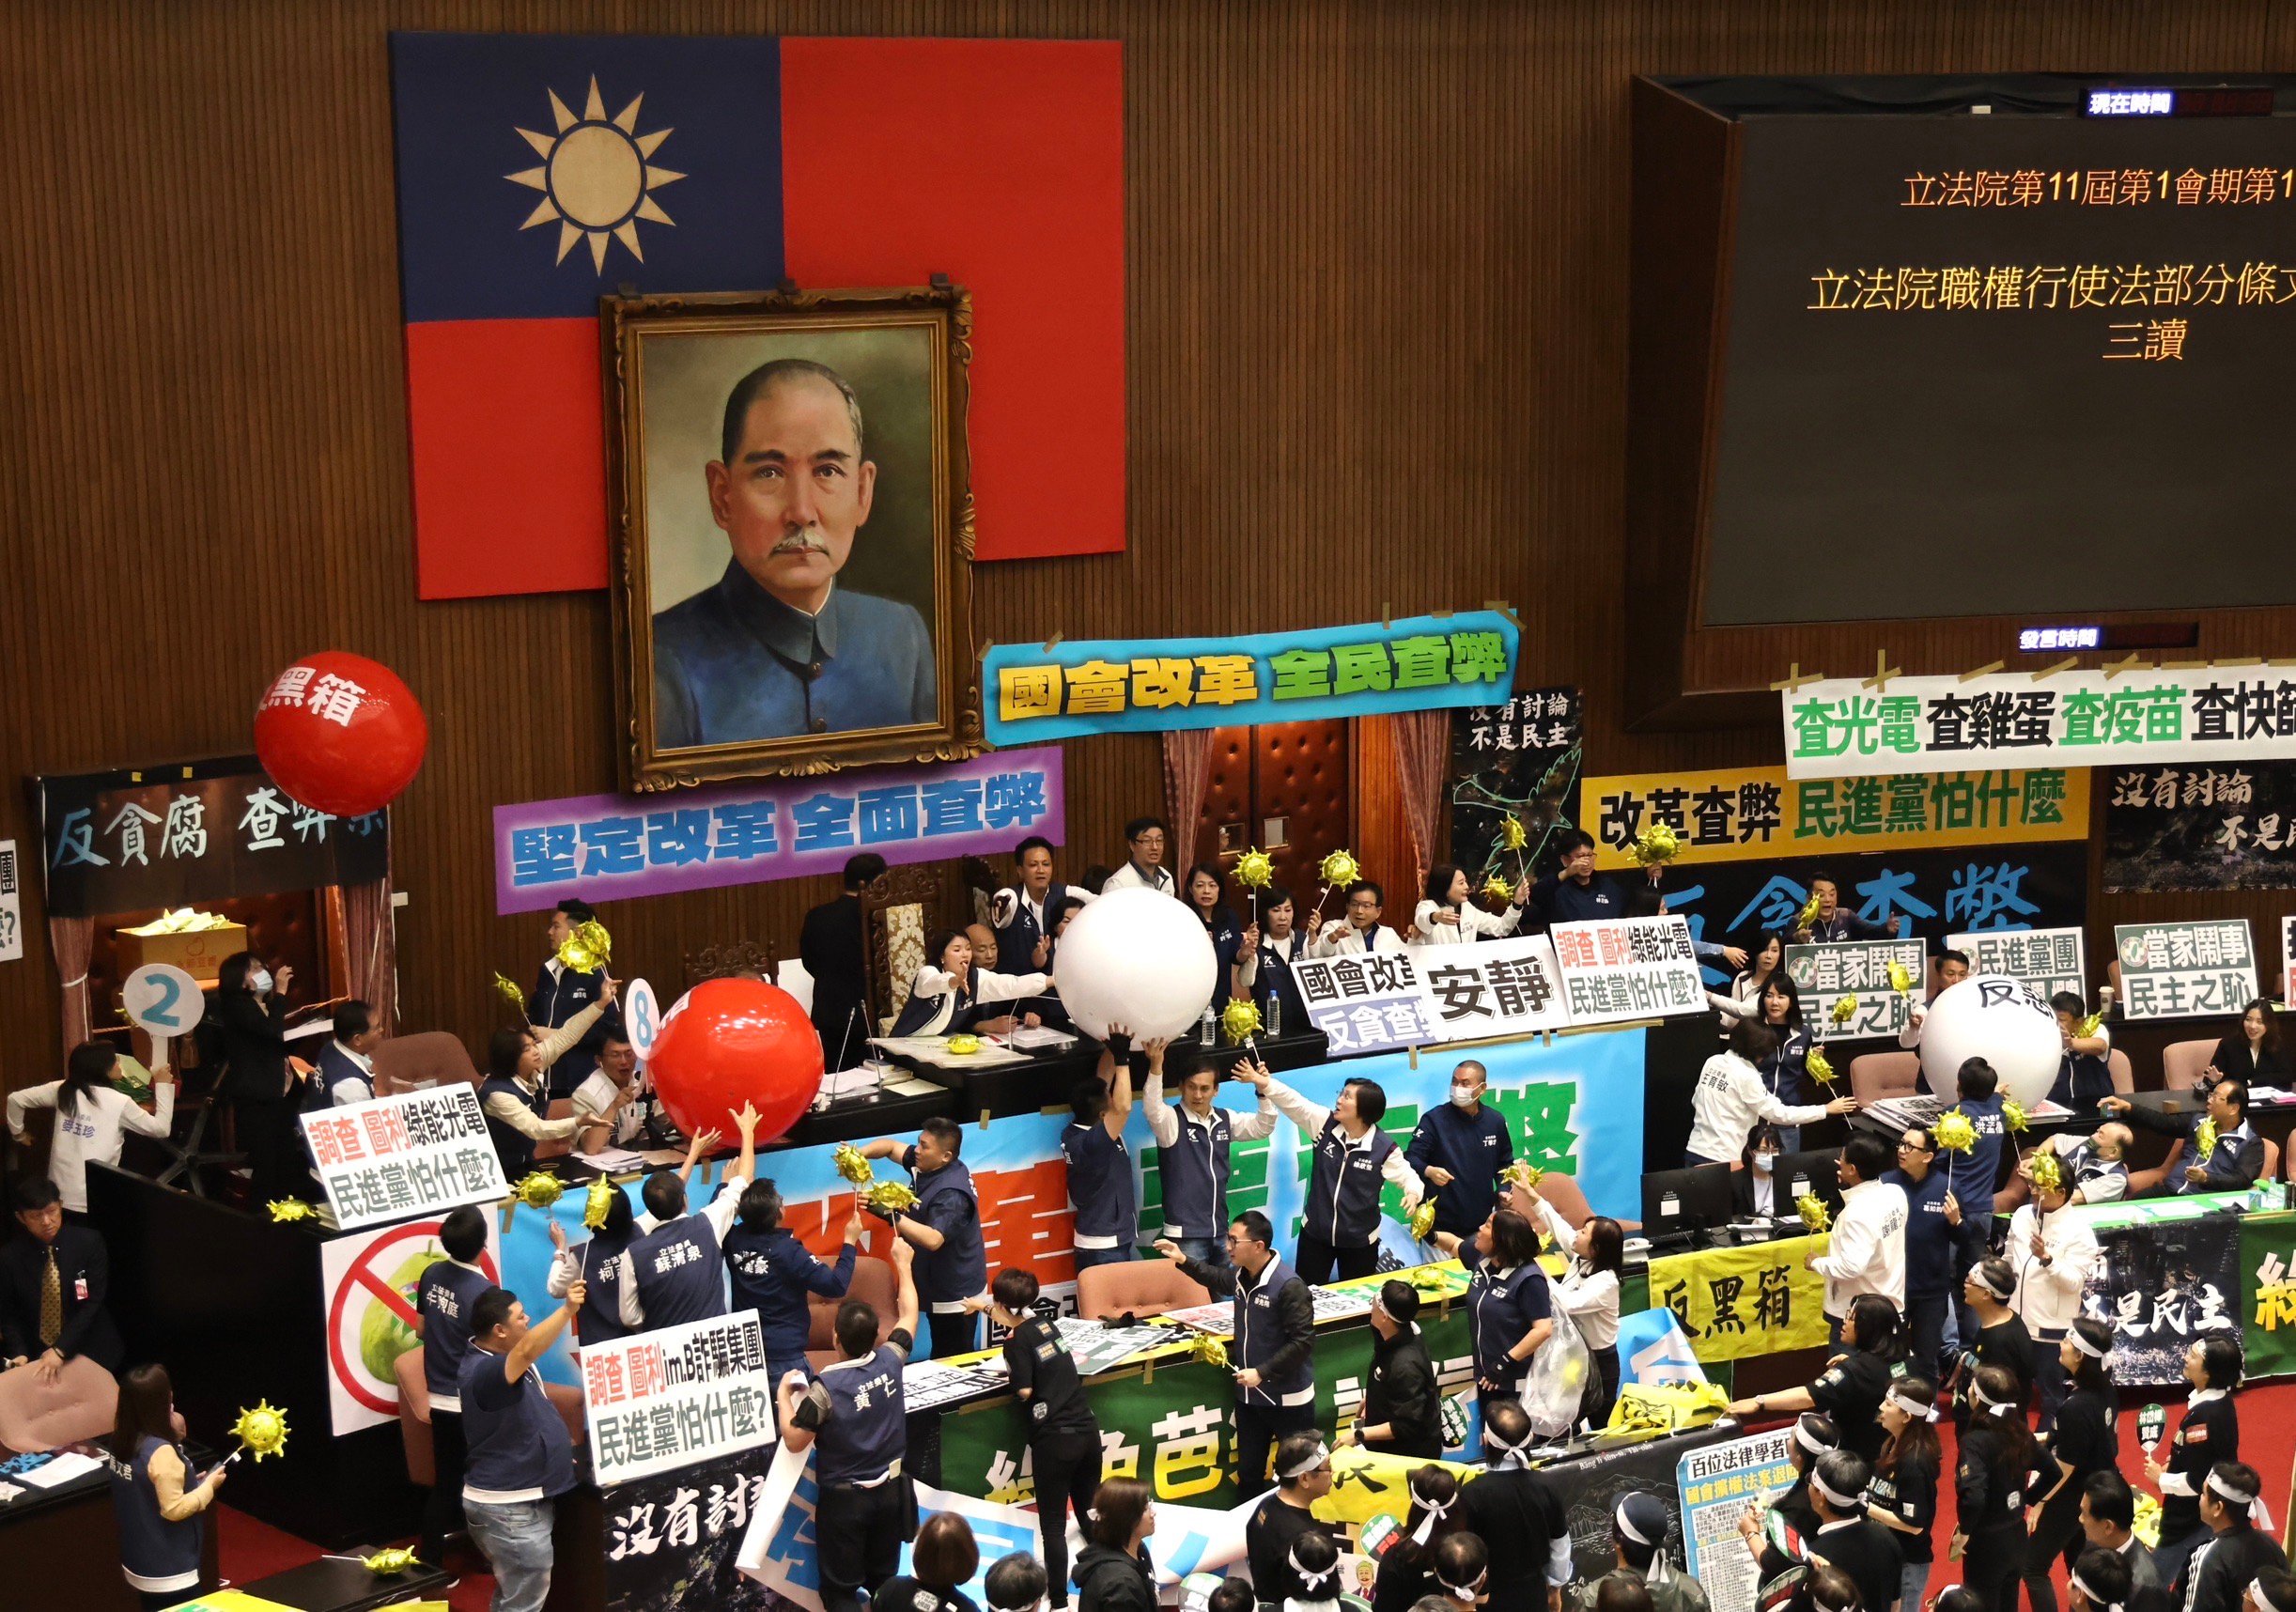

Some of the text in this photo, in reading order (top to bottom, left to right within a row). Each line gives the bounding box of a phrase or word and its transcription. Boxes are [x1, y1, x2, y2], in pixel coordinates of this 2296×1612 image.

[2090, 93, 2171, 114] 現在時間
[1900, 167, 2293, 206] 立法院第11屆第1會期第1
[2102, 318, 2187, 361] 三讀
[2019, 628, 2098, 649] 發言時間
[261, 667, 366, 727] 黑箱
[999, 631, 1507, 721] 國會改革 全民查弊
[1469, 721, 1569, 751] 不是民主
[1792, 695, 1920, 757] 查光電
[1925, 690, 2056, 752] 查雞蛋
[2058, 684, 2187, 746] 查疫苗
[1600, 768, 2067, 852] 改革查弊 民進黨怕什麼
[2110, 768, 2253, 808] 沒有討論
[52, 793, 207, 871] 反貪腐
[511, 770, 1047, 887] 堅定改革 全面查弊
[1556, 928, 1598, 969] 調查
[1814, 945, 1922, 991] 當家鬧事
[1976, 934, 2079, 977] 民進黨團
[2143, 924, 2247, 970] 當家鬧事
[141, 973, 181, 1027] 2
[1296, 953, 1417, 1002] 國會改革
[1427, 955, 1554, 1022] 安靜
[1568, 969, 1699, 1015] 民進黨怕什麼?
[2128, 972, 2252, 1016] 民主之恥
[634, 990, 652, 1047] 8
[308, 1116, 365, 1167] 調查
[329, 1148, 497, 1219] 民進黨怕什麼?
[655, 1245, 703, 1275] 蘇清泉
[1664, 1265, 1791, 1339] 反黑箱
[585, 1350, 626, 1408] 調查
[597, 1386, 768, 1470] 民進黨怕什麼?
[1691, 1437, 1790, 1479] 百位法律學者
